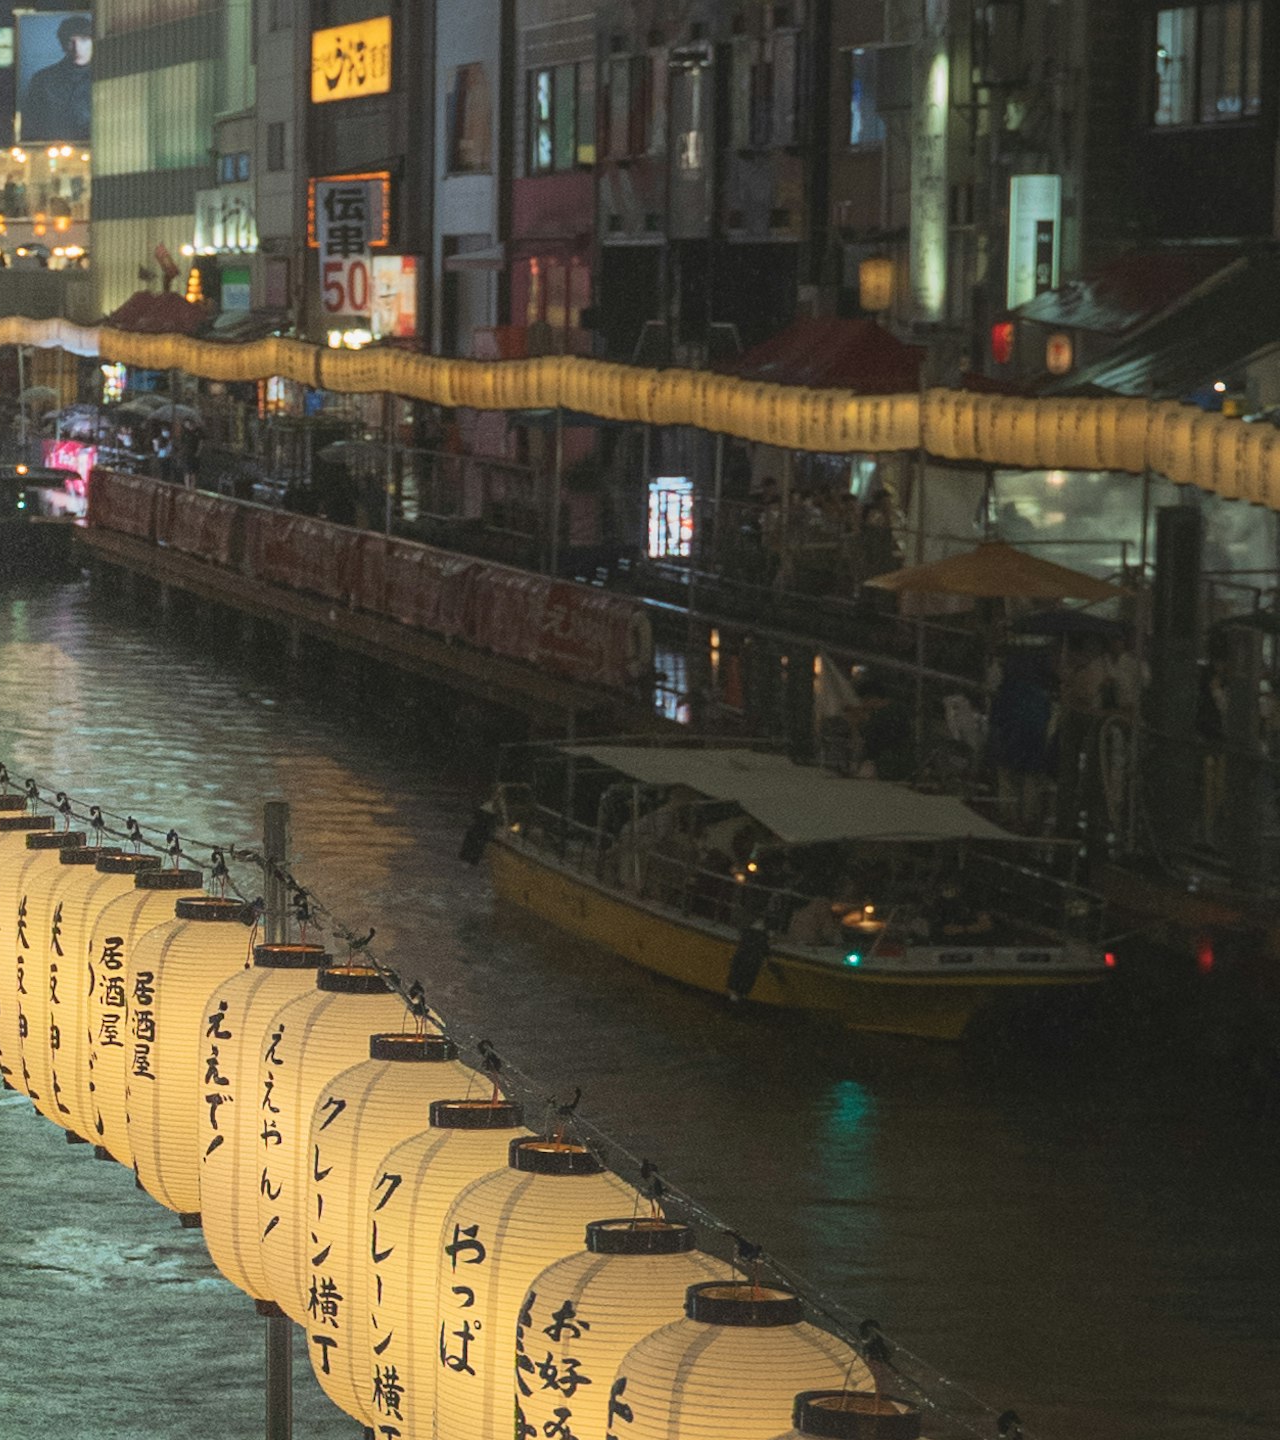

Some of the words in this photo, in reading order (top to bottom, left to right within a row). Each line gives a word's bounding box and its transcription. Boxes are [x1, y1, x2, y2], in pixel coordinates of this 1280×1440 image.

[324, 261, 368, 312] 50
[98, 936, 125, 1048] 居酒屋
[132, 970, 156, 1080] 居酒屋
[307, 1094, 346, 1376] クレーン横丁
[438, 1221, 487, 1377] やっぱ
